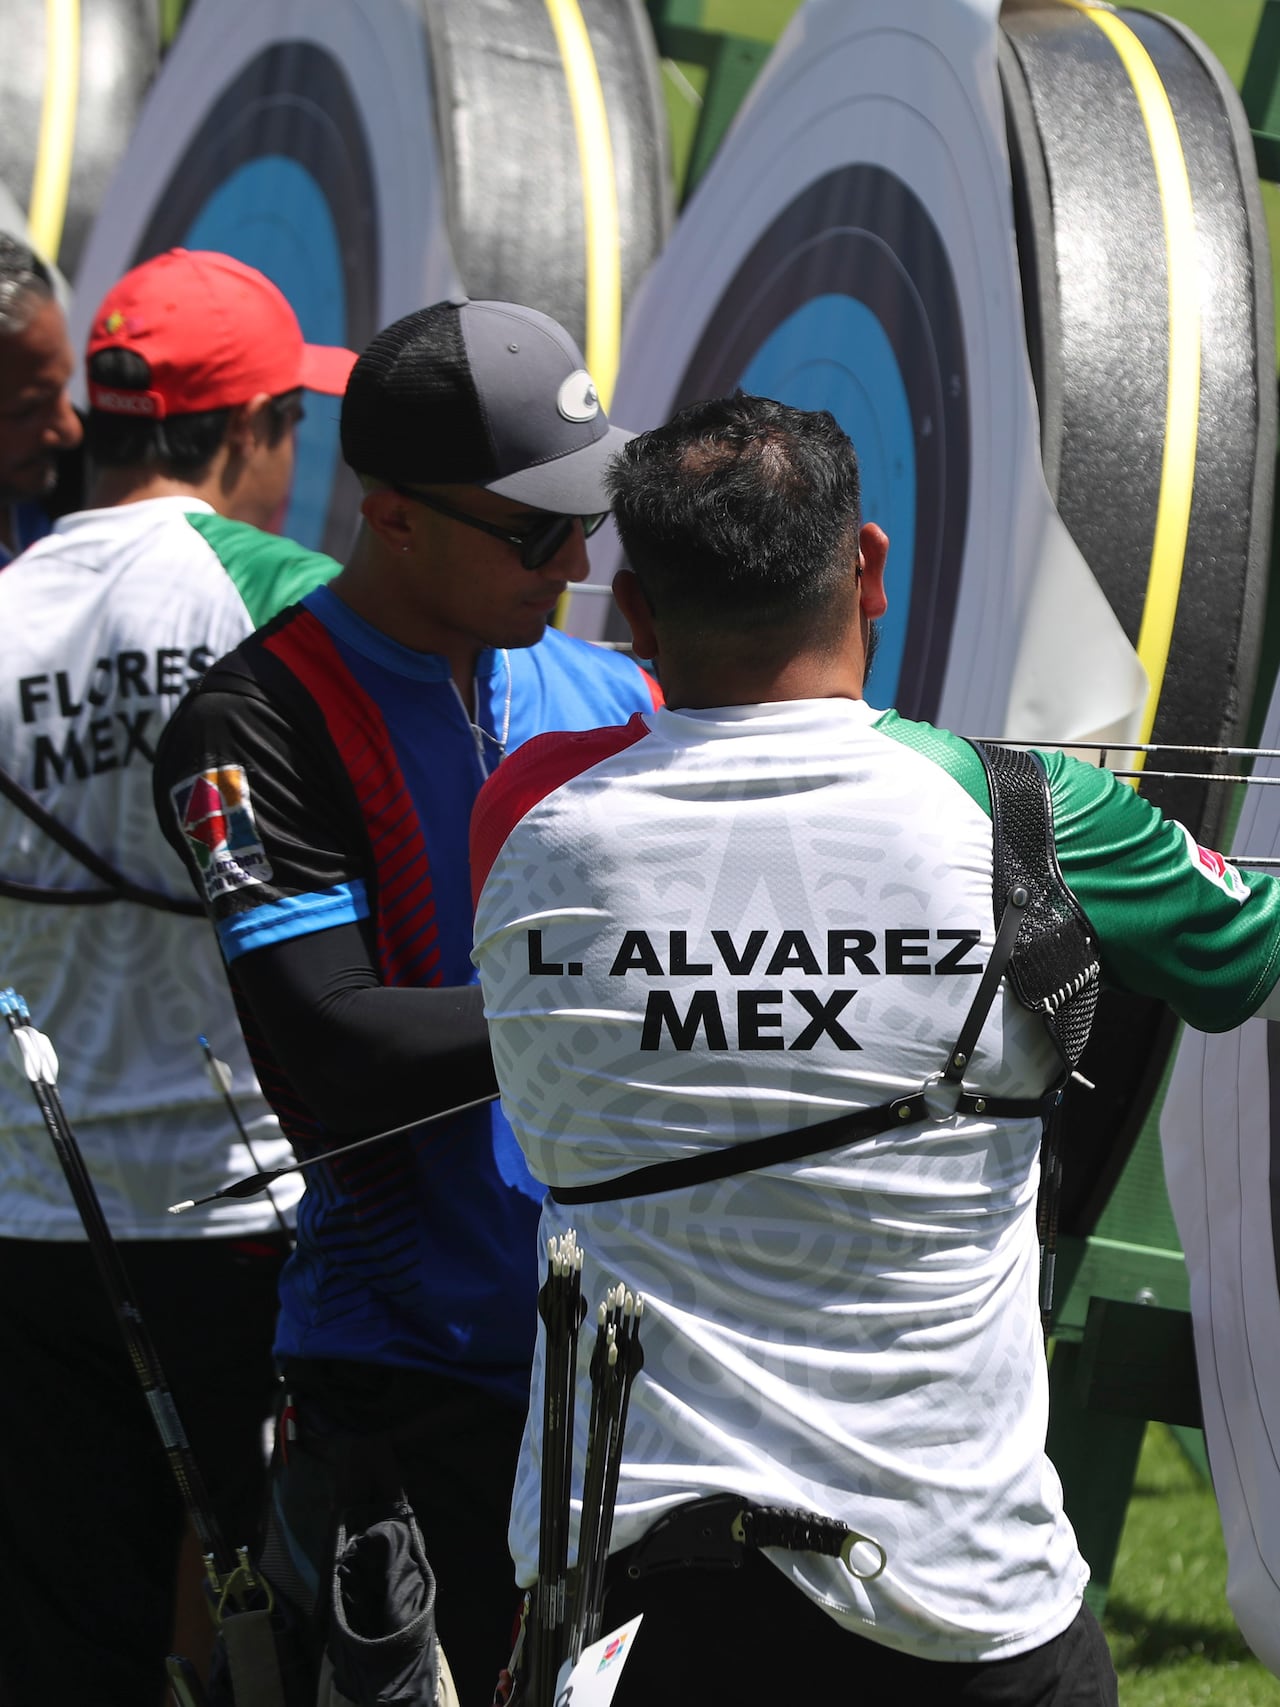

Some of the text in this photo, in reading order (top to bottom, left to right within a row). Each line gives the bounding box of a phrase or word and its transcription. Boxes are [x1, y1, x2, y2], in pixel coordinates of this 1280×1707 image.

[19, 643, 217, 723] FLORES
[33, 707, 156, 790] MEX
[528, 930, 984, 976] L. ALVAREZ
[640, 990, 863, 1051] MEX
